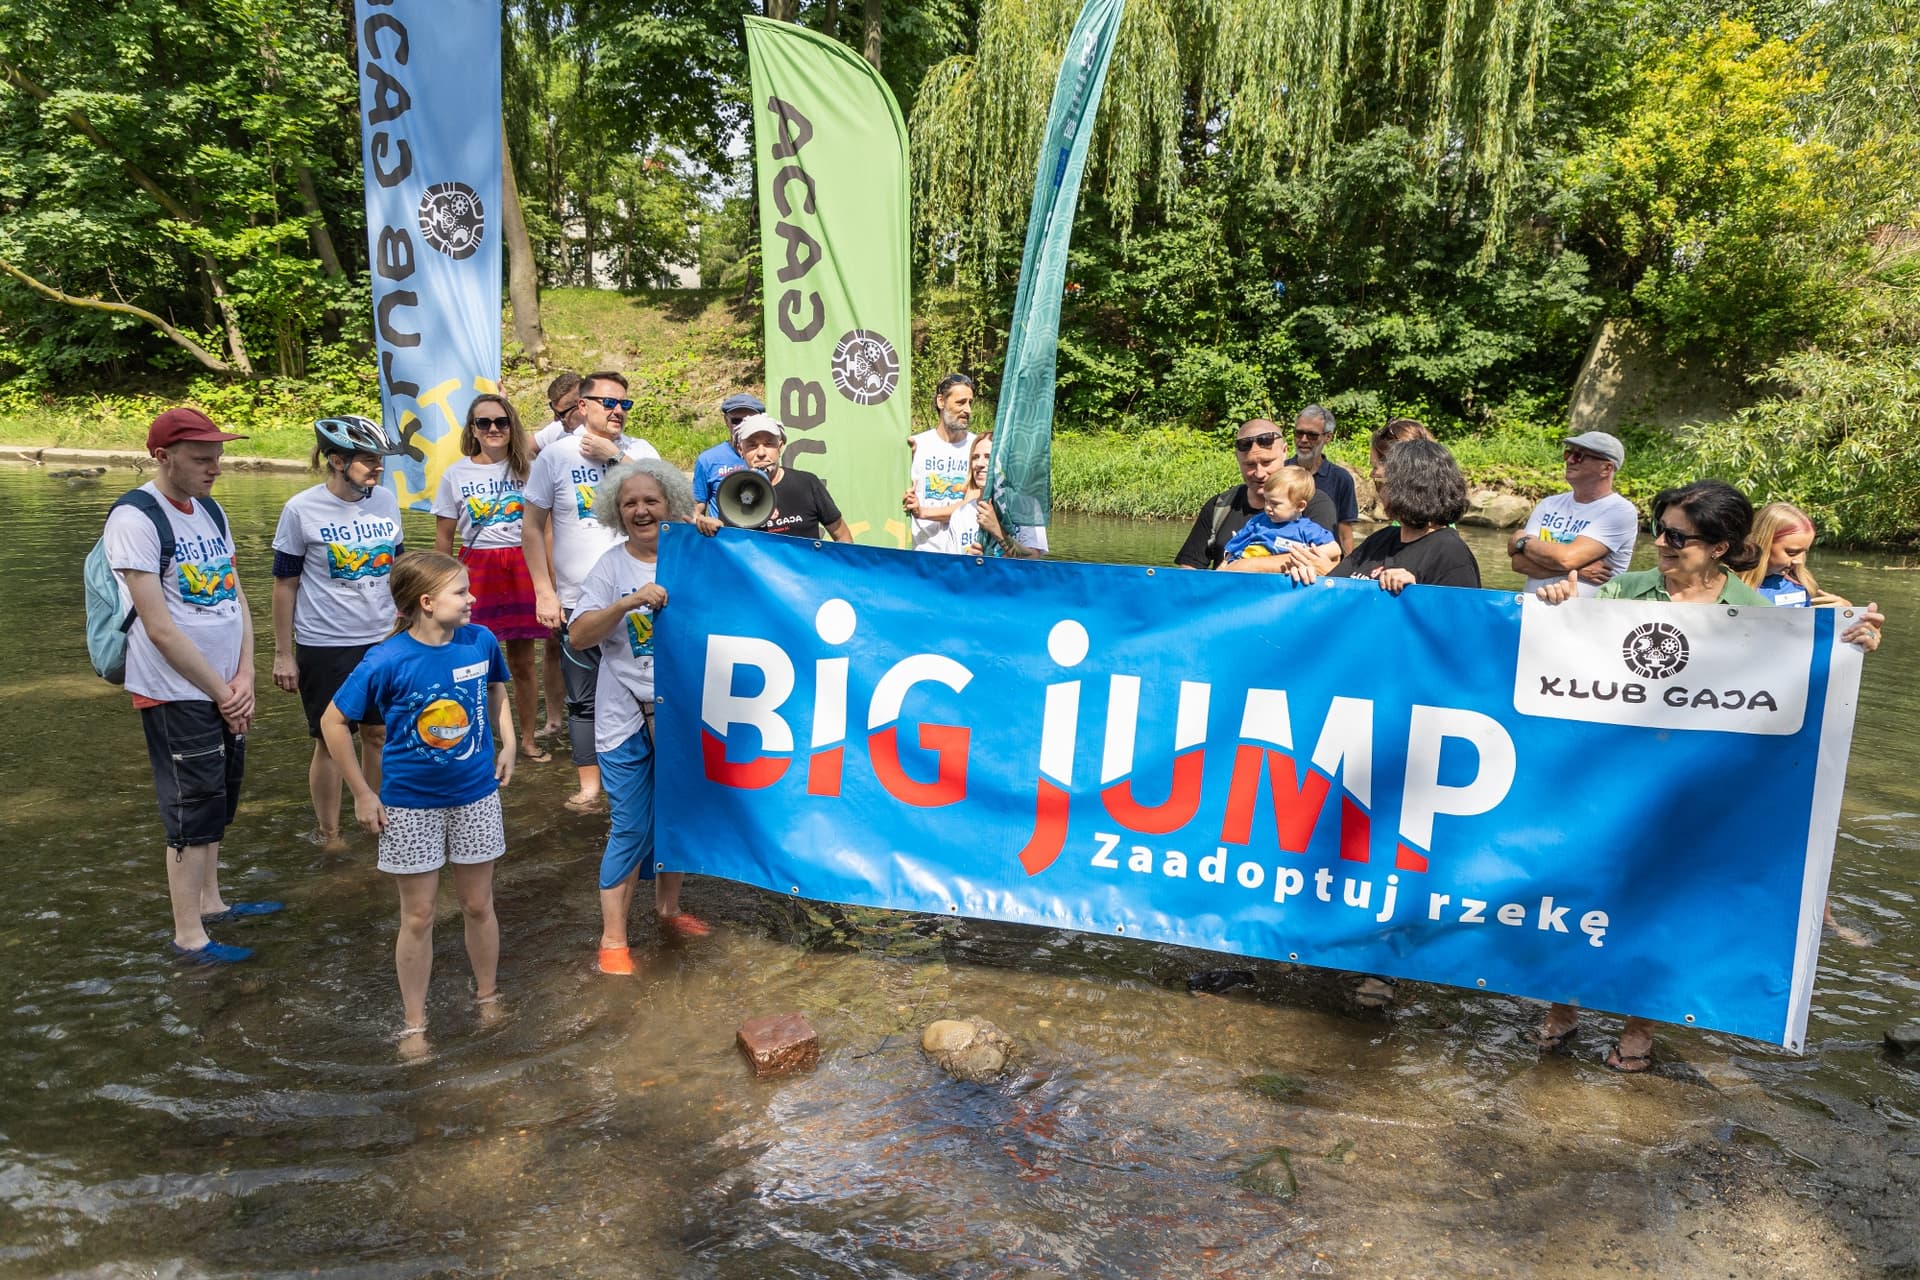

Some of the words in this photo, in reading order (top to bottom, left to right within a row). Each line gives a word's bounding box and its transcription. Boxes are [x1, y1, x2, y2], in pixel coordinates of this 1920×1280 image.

[1540, 676, 1647, 703] KLUB
[1663, 686, 1778, 712] GAJA
[1090, 832, 1398, 923] Zaadoptuj
[1428, 889, 1610, 948] rzekę
